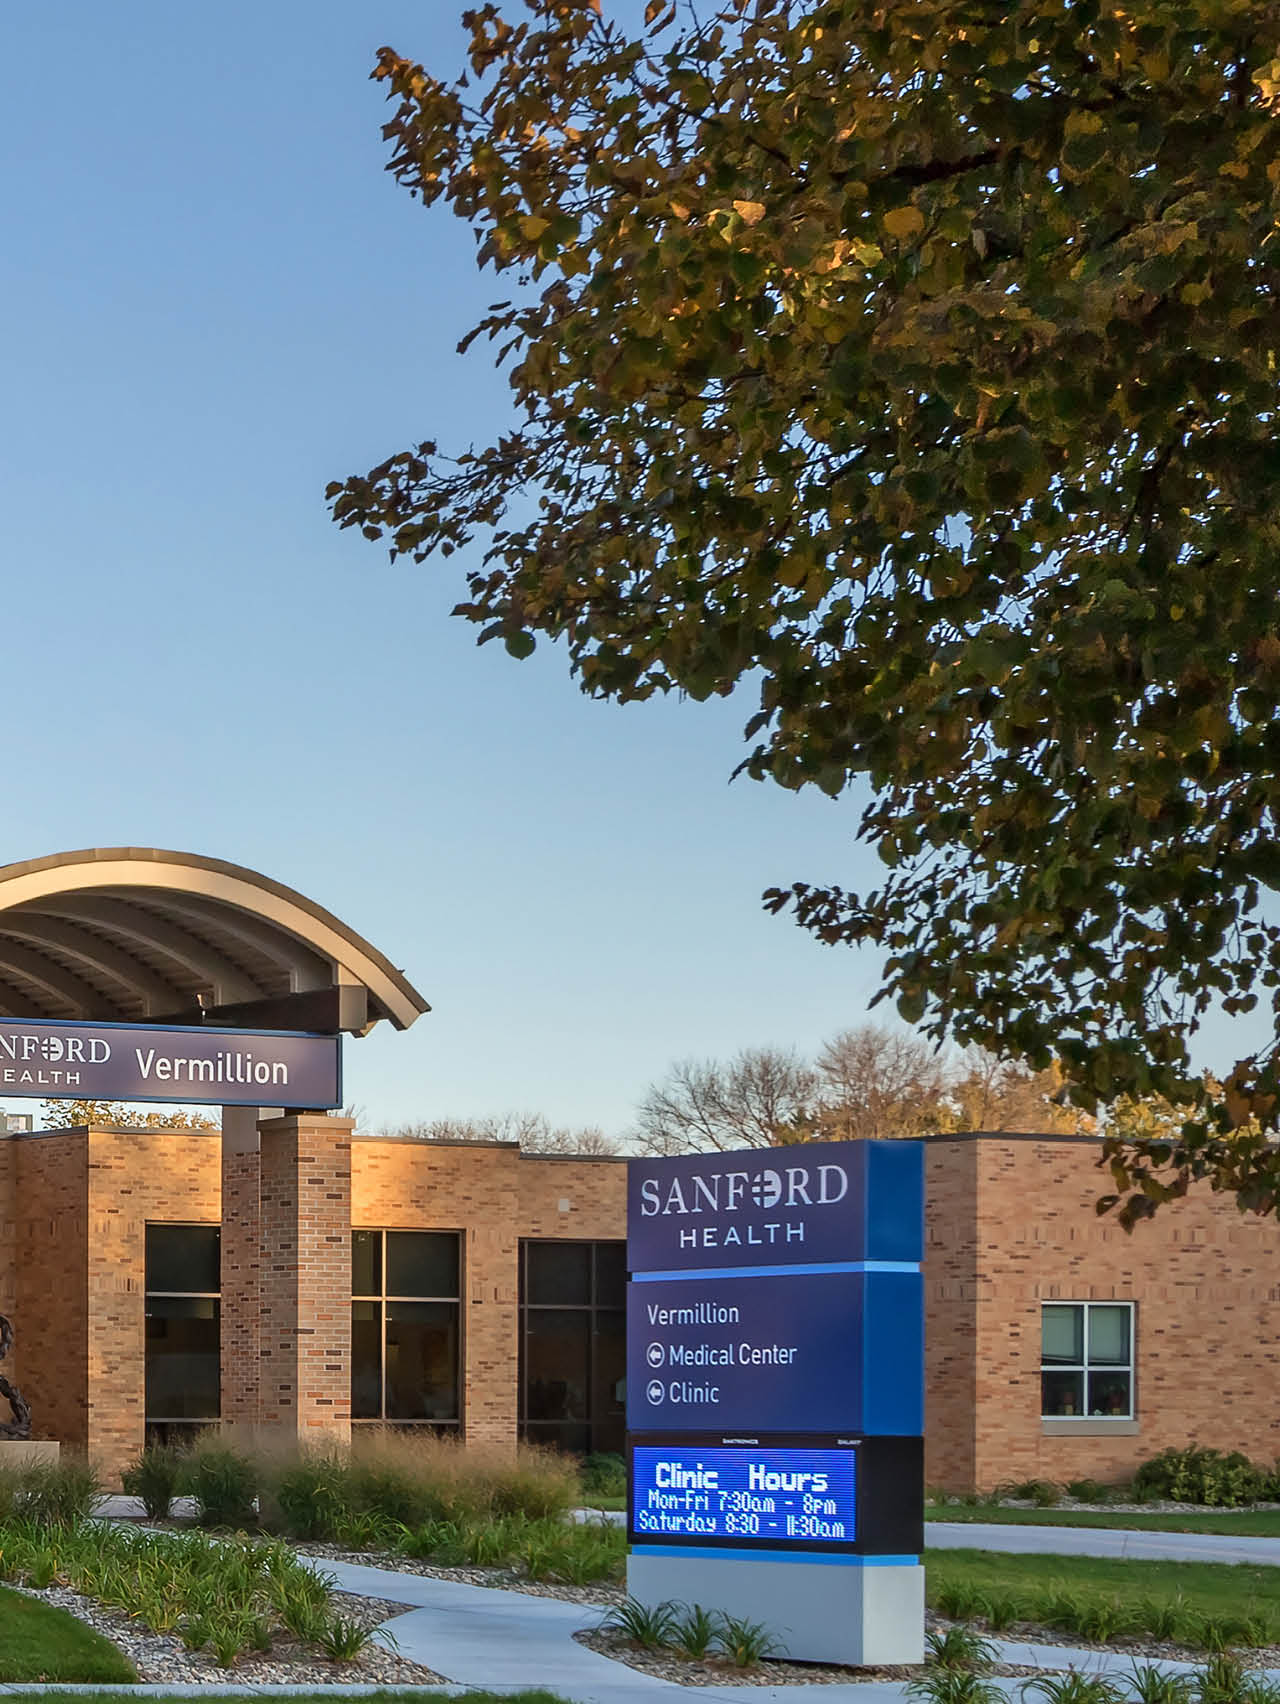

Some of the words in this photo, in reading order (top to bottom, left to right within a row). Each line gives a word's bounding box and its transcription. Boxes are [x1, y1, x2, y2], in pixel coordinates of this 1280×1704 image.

[136, 1048, 289, 1085] Vermillion
[640, 1164, 848, 1216] SANFORD
[679, 1222, 805, 1248] HEALTH
[647, 1303, 740, 1326] Vermillion
[669, 1343, 734, 1366] Medical
[738, 1343, 797, 1366] Center
[669, 1381, 720, 1403] Clinic
[655, 1462, 719, 1489] Clinic
[748, 1463, 829, 1492] Hours
[647, 1489, 709, 1510] Mon-Fri
[717, 1491, 776, 1513] 7:30am
[802, 1493, 837, 1515] 8pm
[639, 1510, 717, 1533] Saturday
[725, 1513, 760, 1534] 8:30
[786, 1514, 846, 1539] 11:30am
